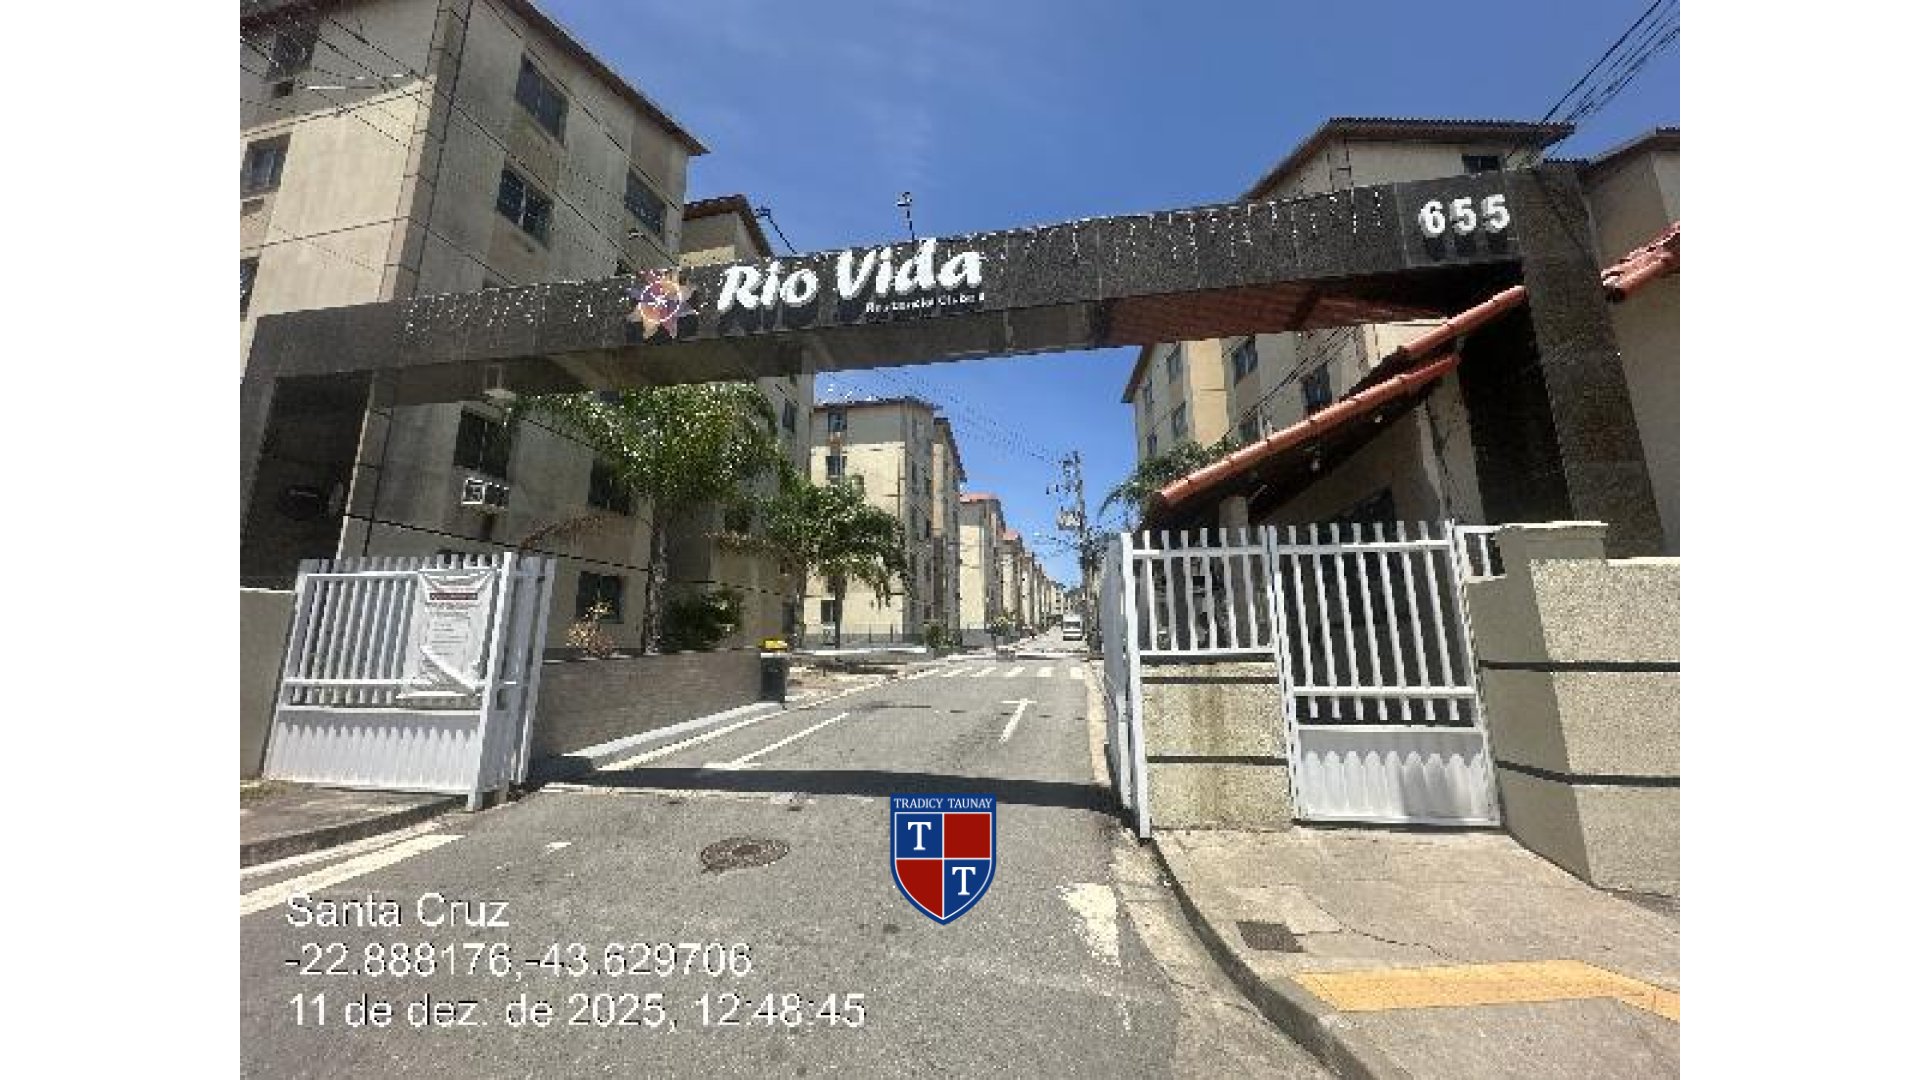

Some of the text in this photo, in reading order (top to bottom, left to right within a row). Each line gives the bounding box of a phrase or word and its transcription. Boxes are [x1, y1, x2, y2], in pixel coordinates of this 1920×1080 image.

[1418, 194, 1510, 237] 655
[717, 238, 983, 312] Rio Vida
